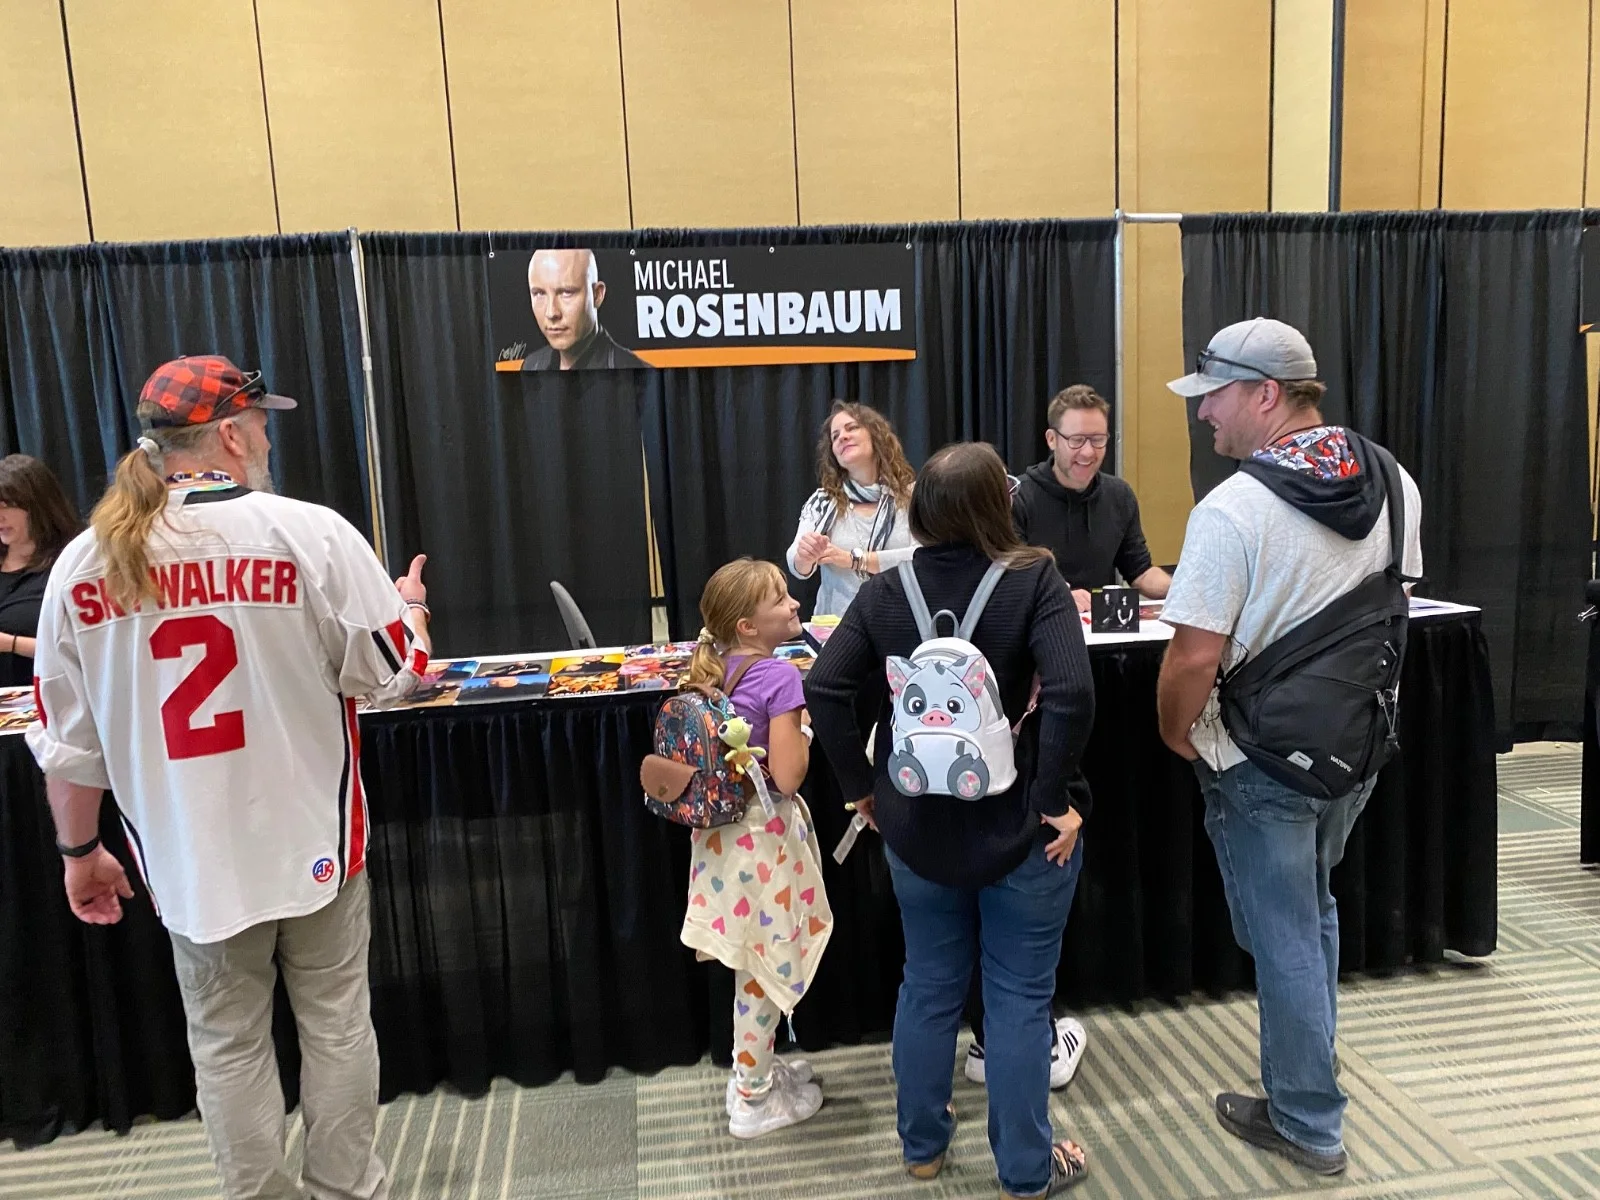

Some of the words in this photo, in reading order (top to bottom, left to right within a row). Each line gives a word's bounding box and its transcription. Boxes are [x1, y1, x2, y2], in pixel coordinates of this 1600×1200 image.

[634, 259, 734, 290] MICHAEL
[636, 289, 901, 338] ROSENBAUM
[71, 558, 297, 625] SKWALKER
[149, 615, 245, 760] 2
